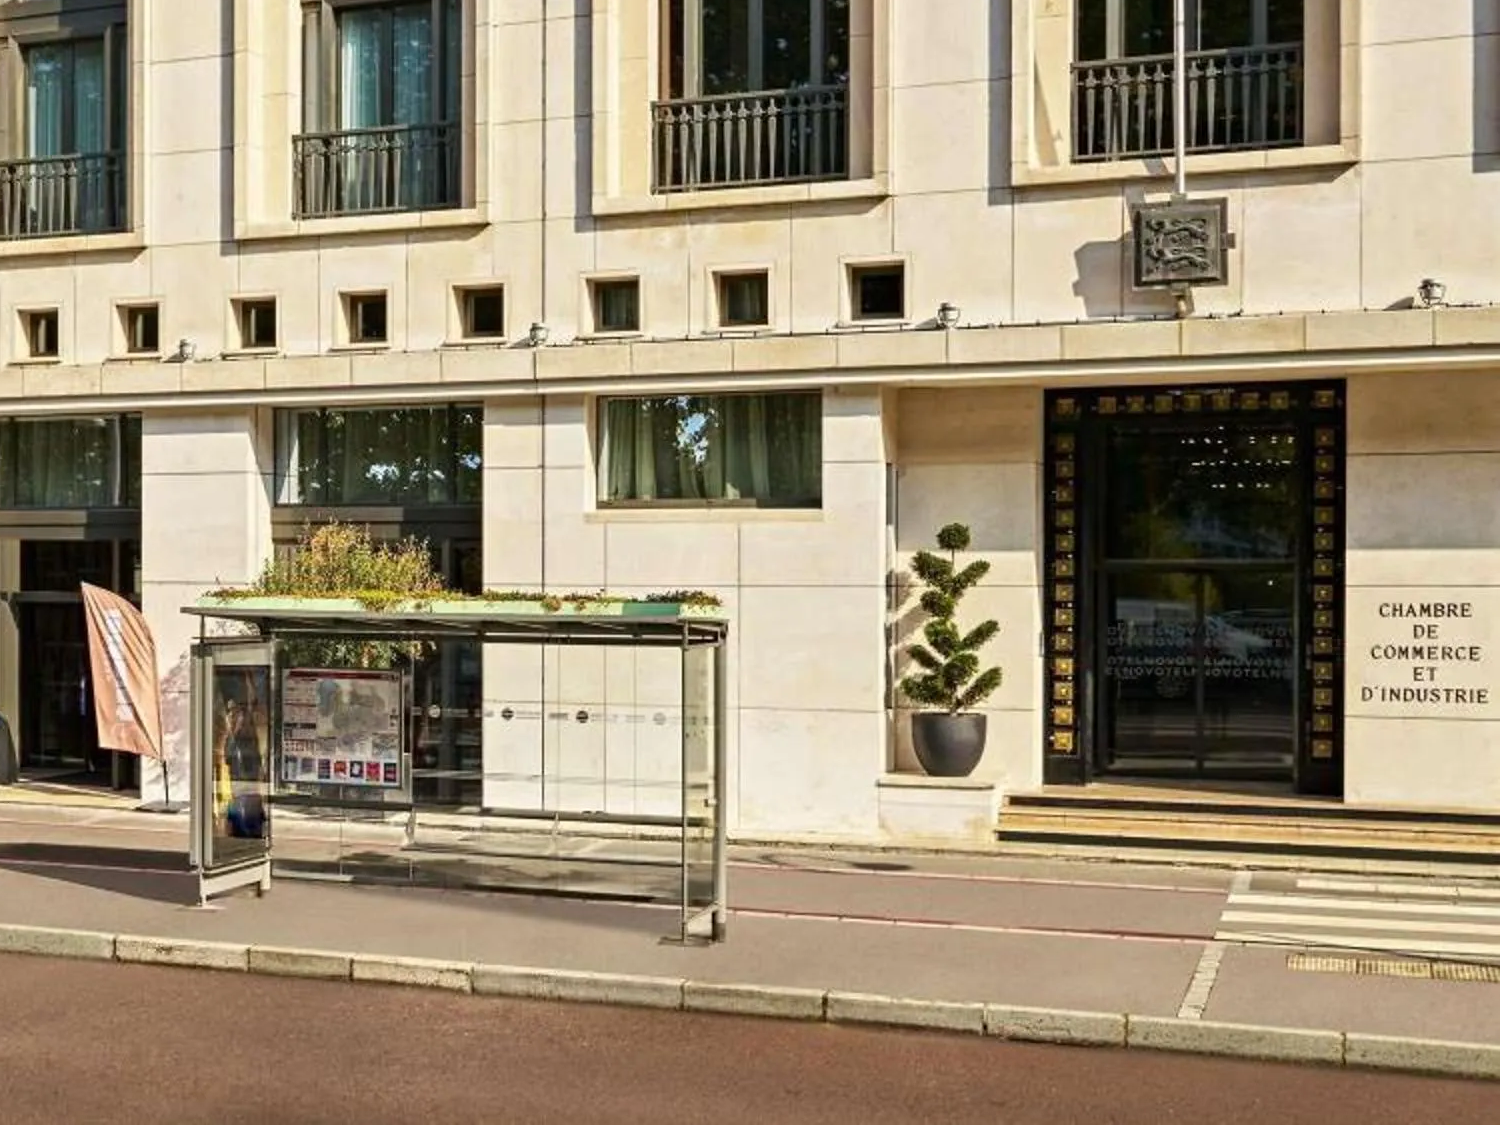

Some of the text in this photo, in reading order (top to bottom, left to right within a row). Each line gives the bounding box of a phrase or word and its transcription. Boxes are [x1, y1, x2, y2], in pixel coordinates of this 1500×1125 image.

[1379, 602, 1473, 618] CHAMBRE
[1412, 624, 1440, 639] DE
[1370, 645, 1482, 661] COMMERCE
[1412, 666, 1438, 682] ET
[1361, 686, 1489, 704] D'INDUSTRIE
